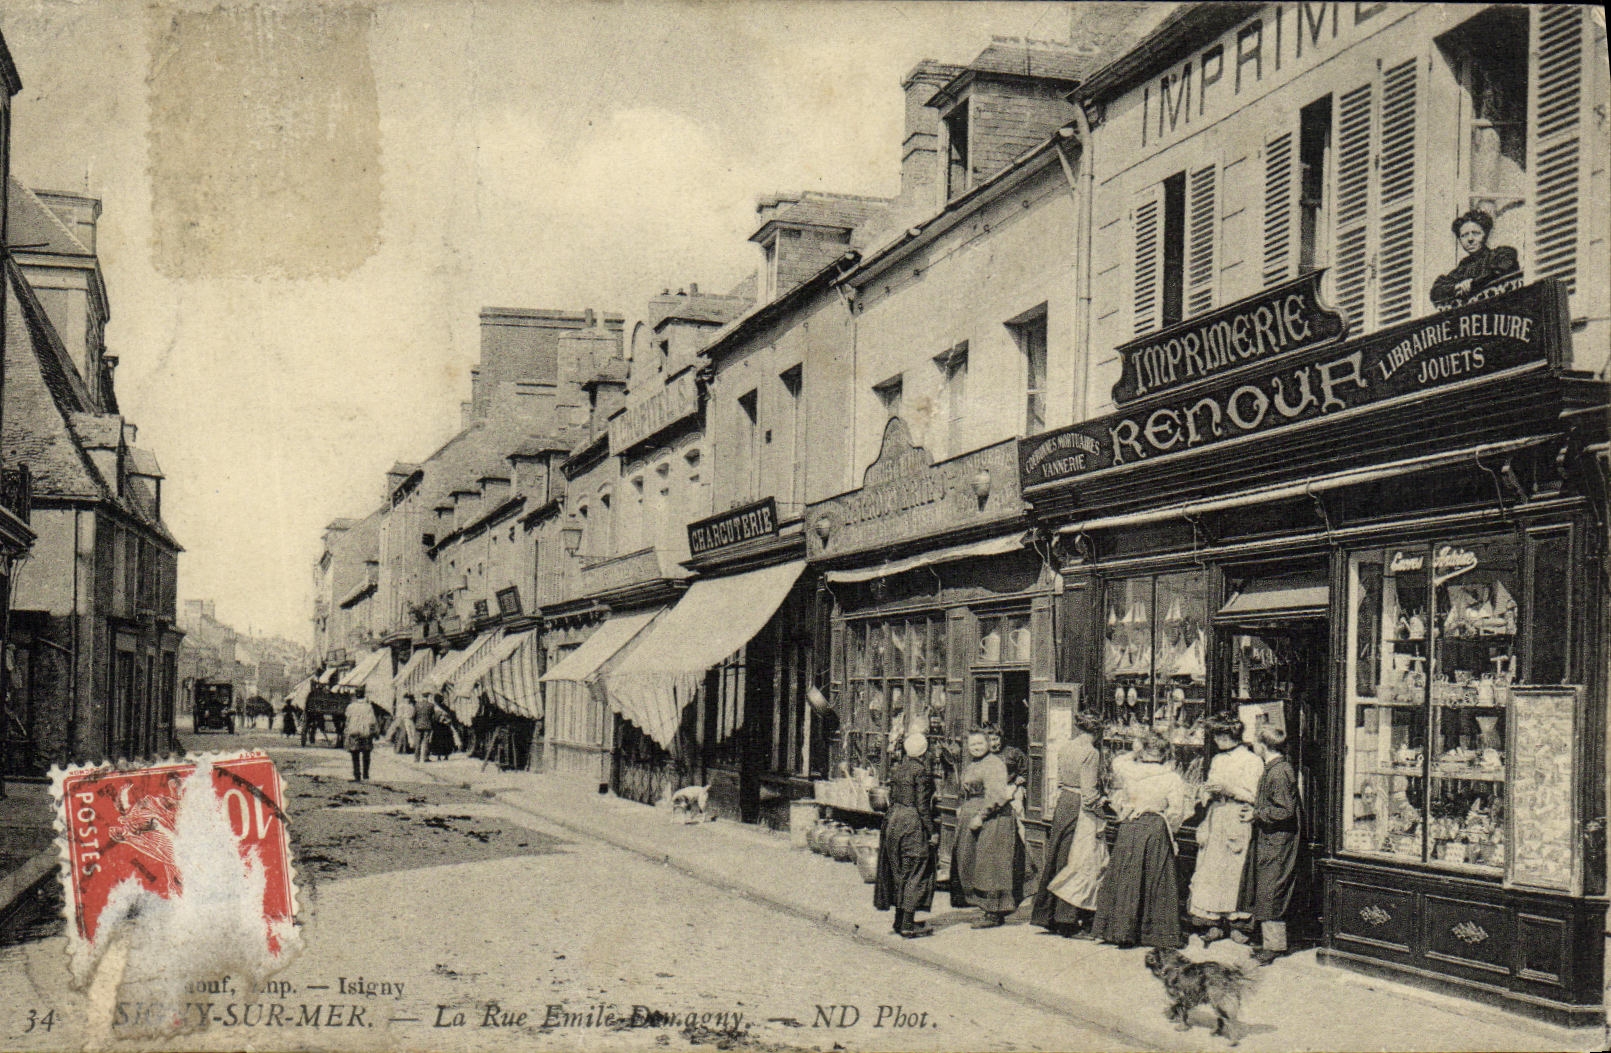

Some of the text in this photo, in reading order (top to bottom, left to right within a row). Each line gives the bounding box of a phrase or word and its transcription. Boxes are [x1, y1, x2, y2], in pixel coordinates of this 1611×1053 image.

[1132, 295, 1312, 396] IMPRIMERIE
[1459, 314, 1533, 343] RELIURE
[1417, 347, 1485, 384] JOUETS
[1042, 454, 1086, 478] VANNERIE
[691, 506, 773, 552] CHARCUTERIE
[75, 792, 101, 876] POSTES
